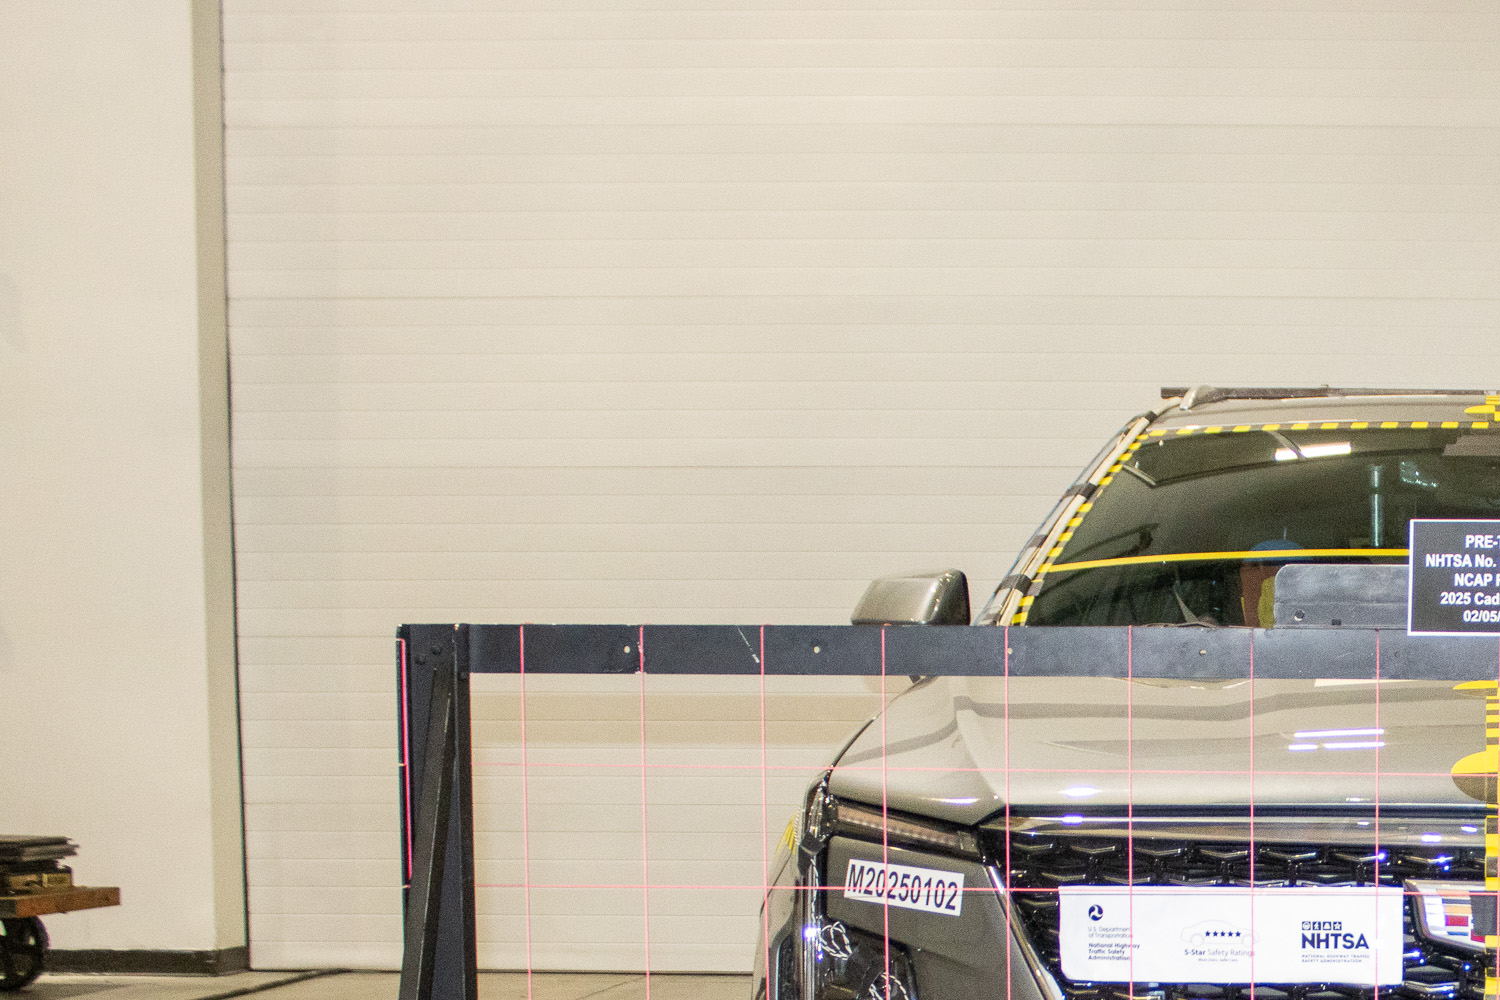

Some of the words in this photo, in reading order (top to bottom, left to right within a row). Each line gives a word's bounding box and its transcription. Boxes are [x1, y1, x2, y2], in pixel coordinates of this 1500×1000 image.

[1425, 554, 1472, 567] NHTSA
[1474, 554, 1497, 568] No.
[1454, 573, 1493, 587] NCAP
[1440, 592, 1471, 605] 2025
[847, 864, 958, 911] M20250102
[1302, 933, 1370, 949] NHTSA
[1208, 949, 1228, 957] Safety
